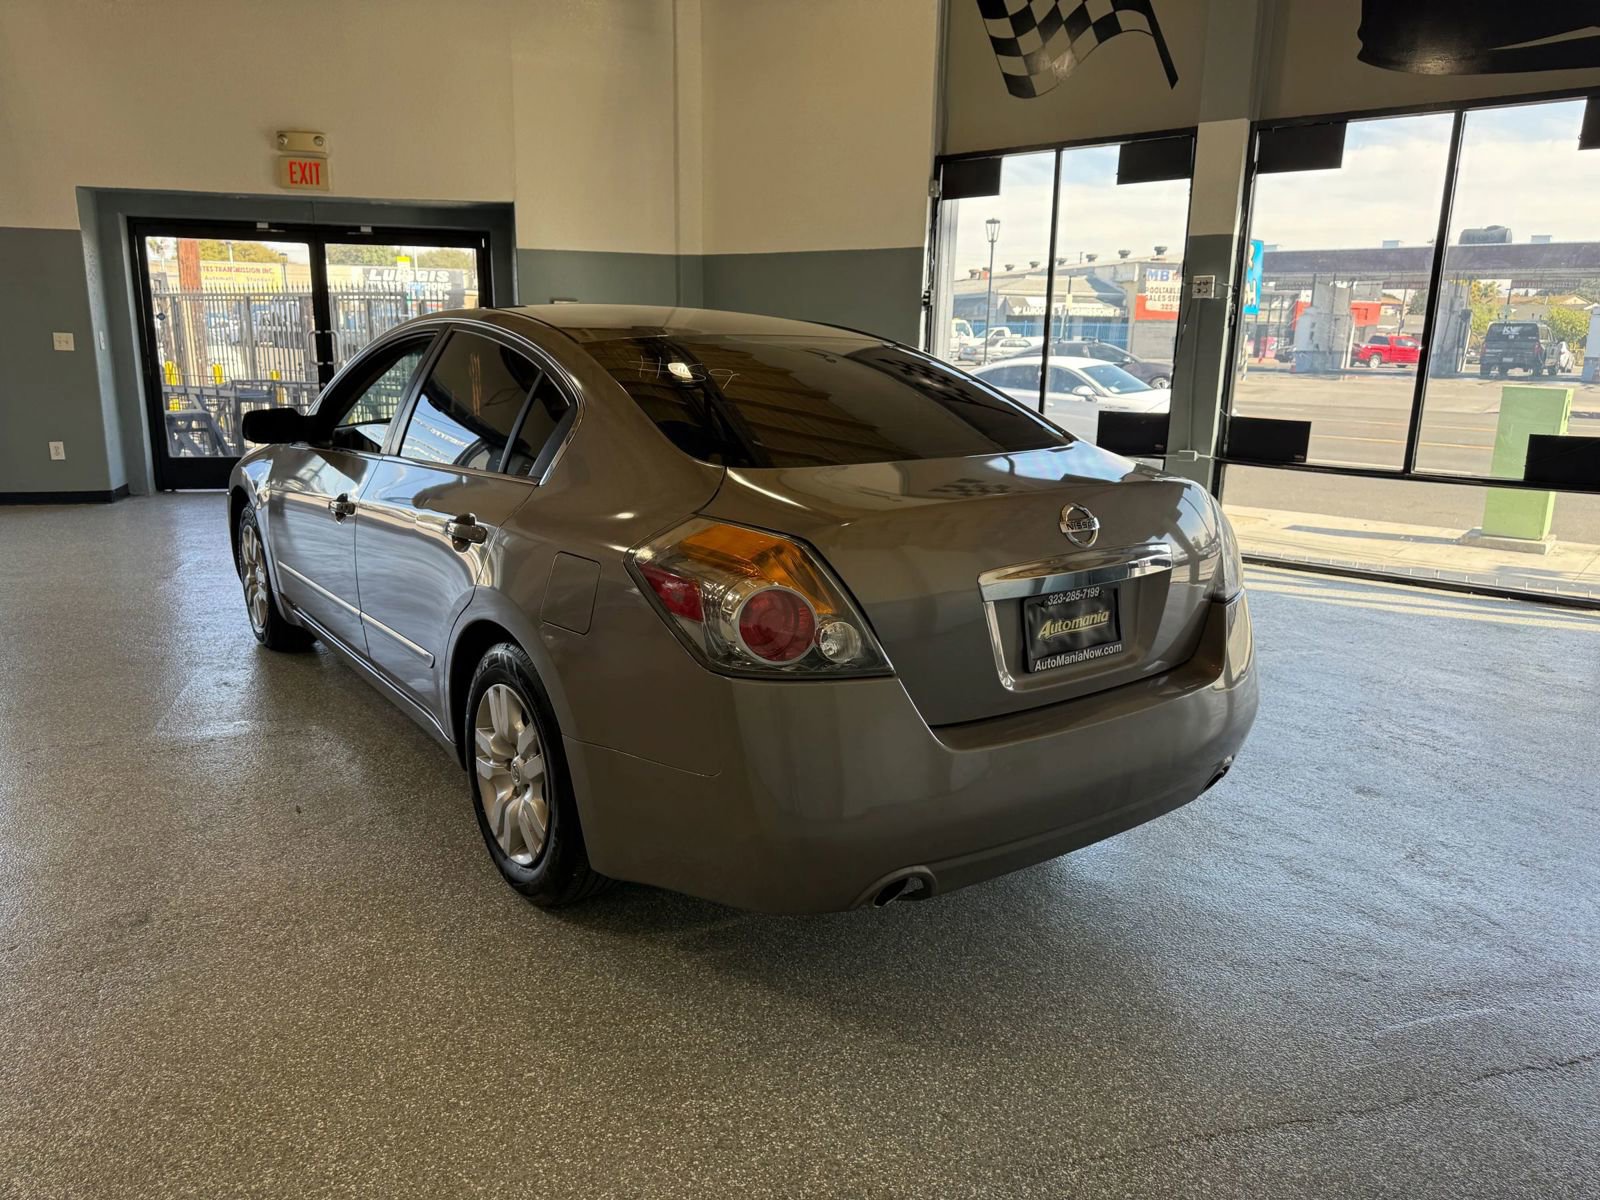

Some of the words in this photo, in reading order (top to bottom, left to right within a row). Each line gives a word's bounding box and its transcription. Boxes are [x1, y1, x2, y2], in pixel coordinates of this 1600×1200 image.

[288, 160, 321, 186] EXIT
[1065, 519, 1097, 531] NISSAN
[1047, 586, 1100, 606] 323-285-7199
[1038, 610, 1110, 641] Automania
[1034, 643, 1123, 673] AutoManiaNow.com
